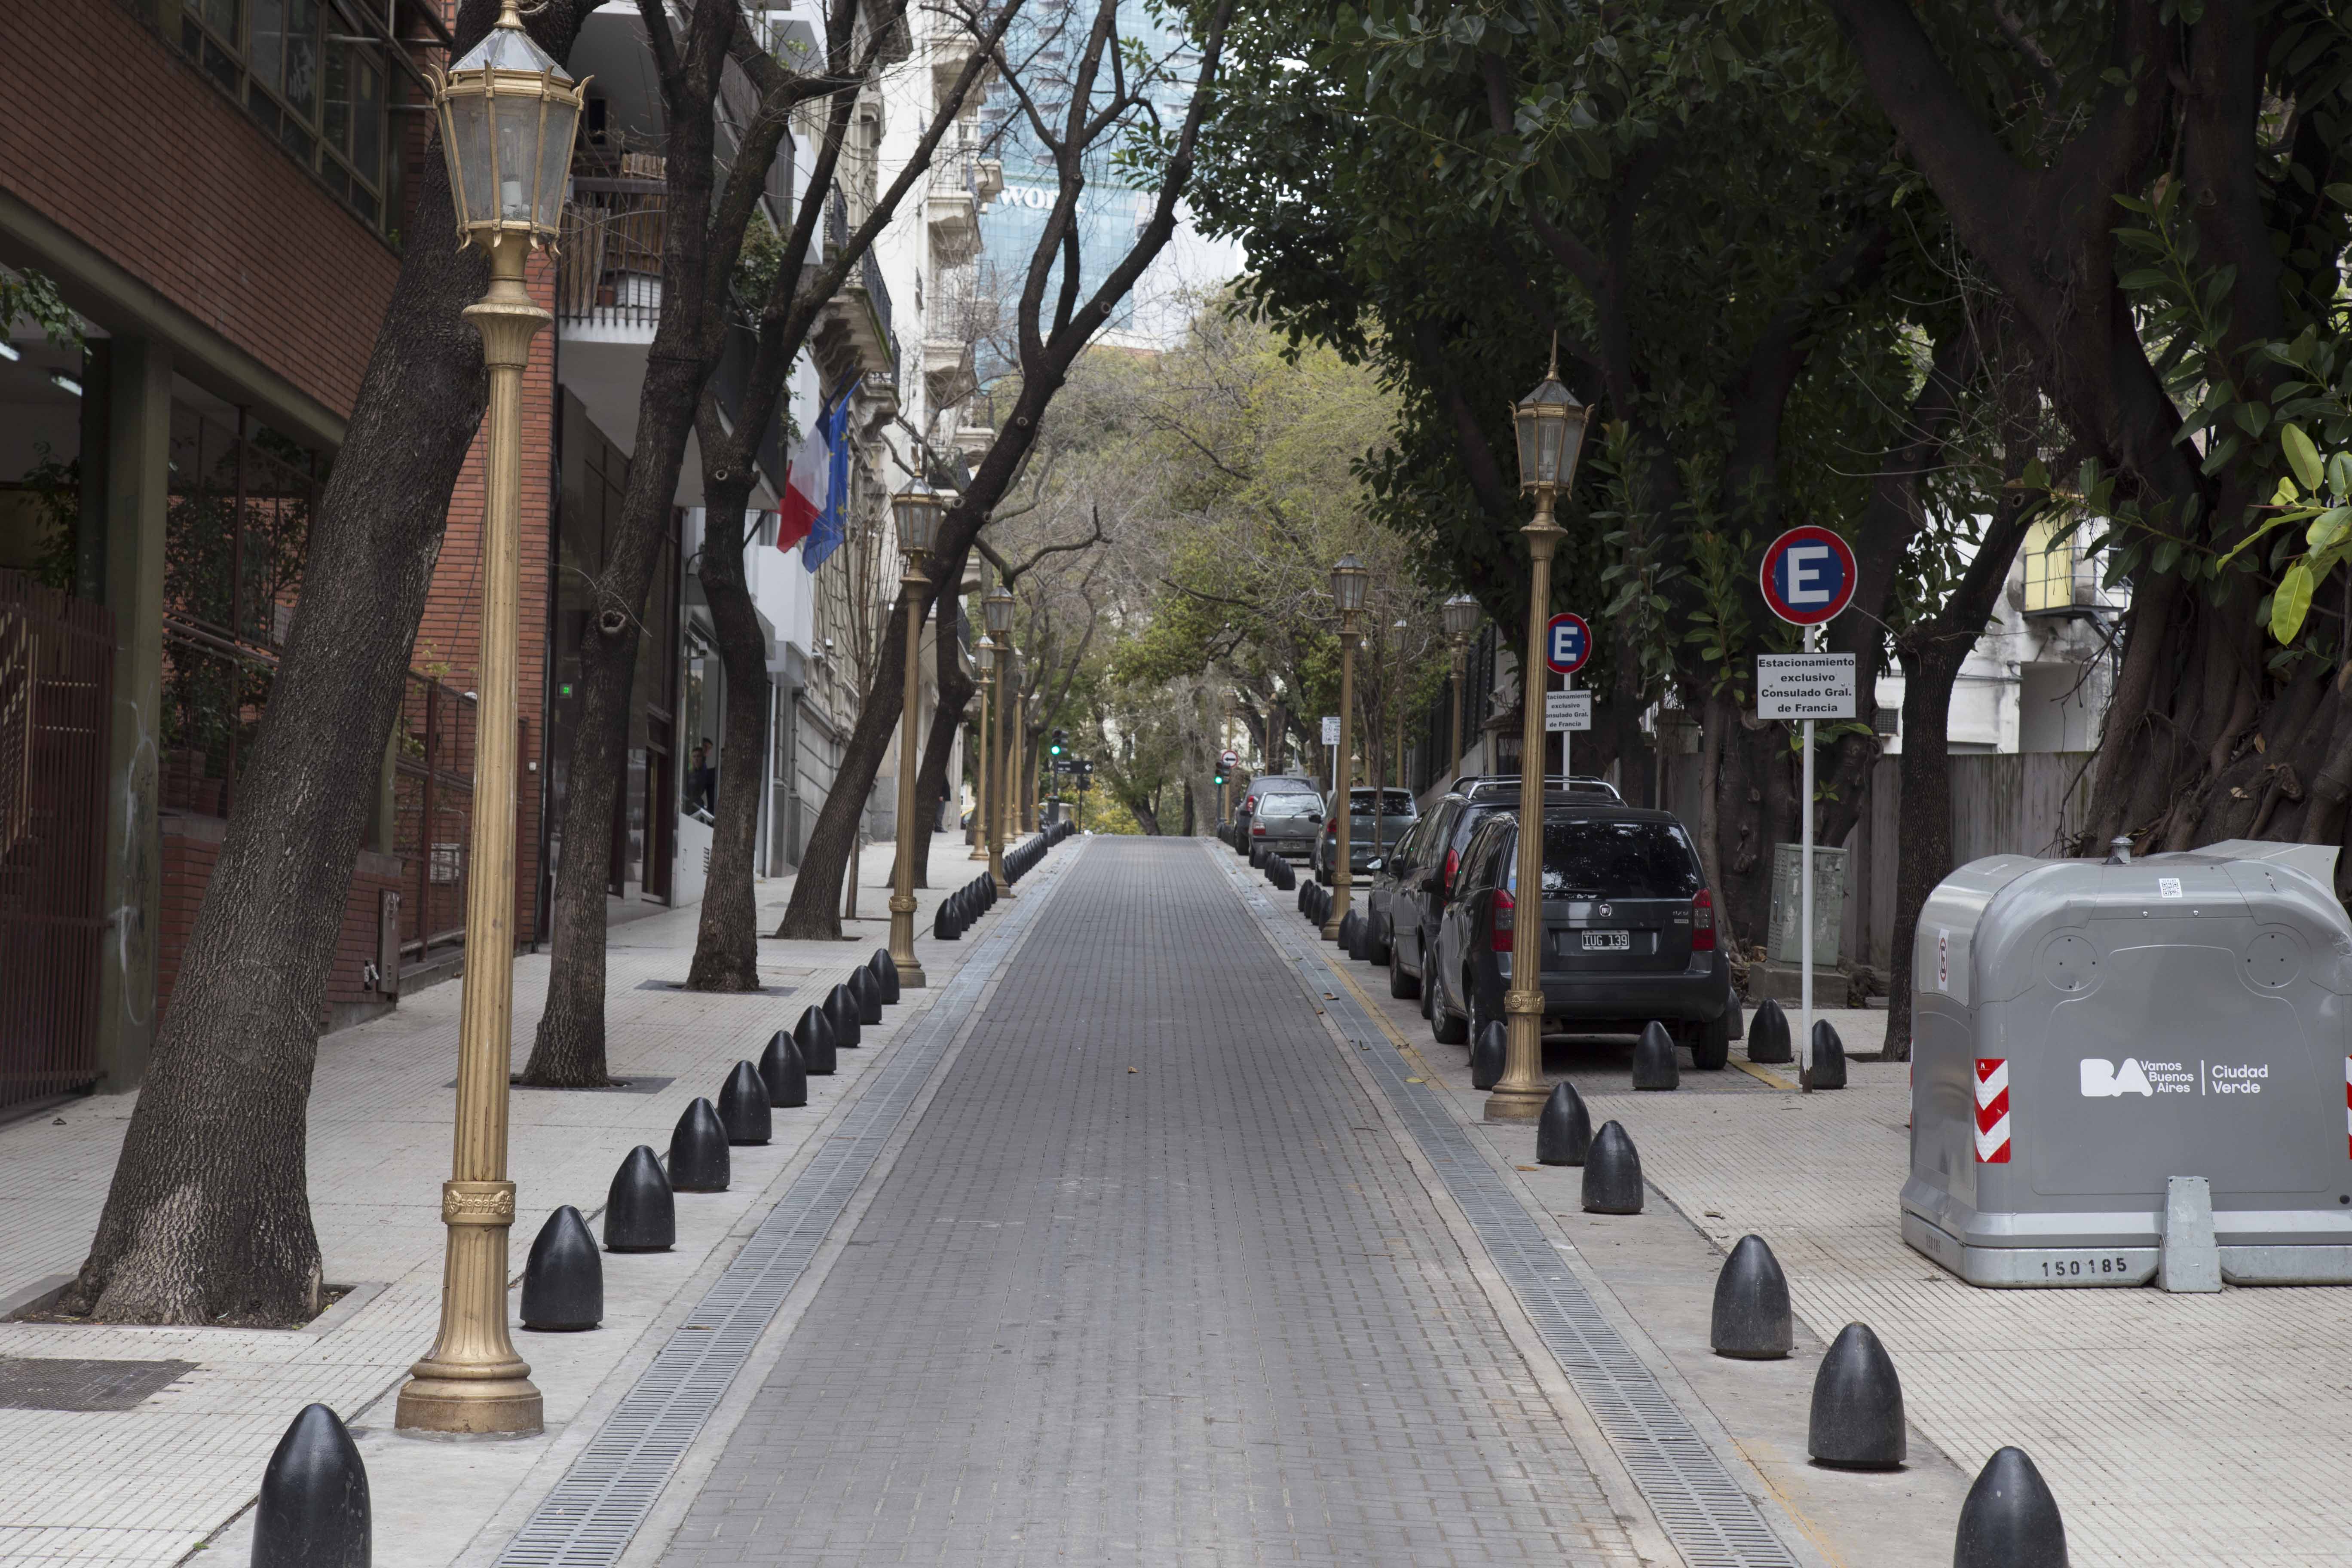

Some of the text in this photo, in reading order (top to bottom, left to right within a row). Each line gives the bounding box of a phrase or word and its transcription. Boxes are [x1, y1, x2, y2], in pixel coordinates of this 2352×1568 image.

[1788, 545, 1829, 604] E
[1554, 626, 1578, 662] E
[1759, 658, 1854, 667] Estacionamiento
[1781, 674, 1835, 682] exclusivo
[1761, 688, 1852, 697] Consulado Gral.
[1795, 704, 1838, 712] Francia
[1584, 935, 1628, 946] IUG 139
[2141, 1060, 2182, 1071] Vamos
[2211, 1064, 2269, 1078] Ciudad
[2080, 1058, 2153, 1097] BA
[2149, 1072, 2194, 1082] Buenos
[2156, 1082, 2191, 1093] Aires
[2212, 1080, 2261, 1094] Verde
[2042, 1257, 2127, 1277] 150185
